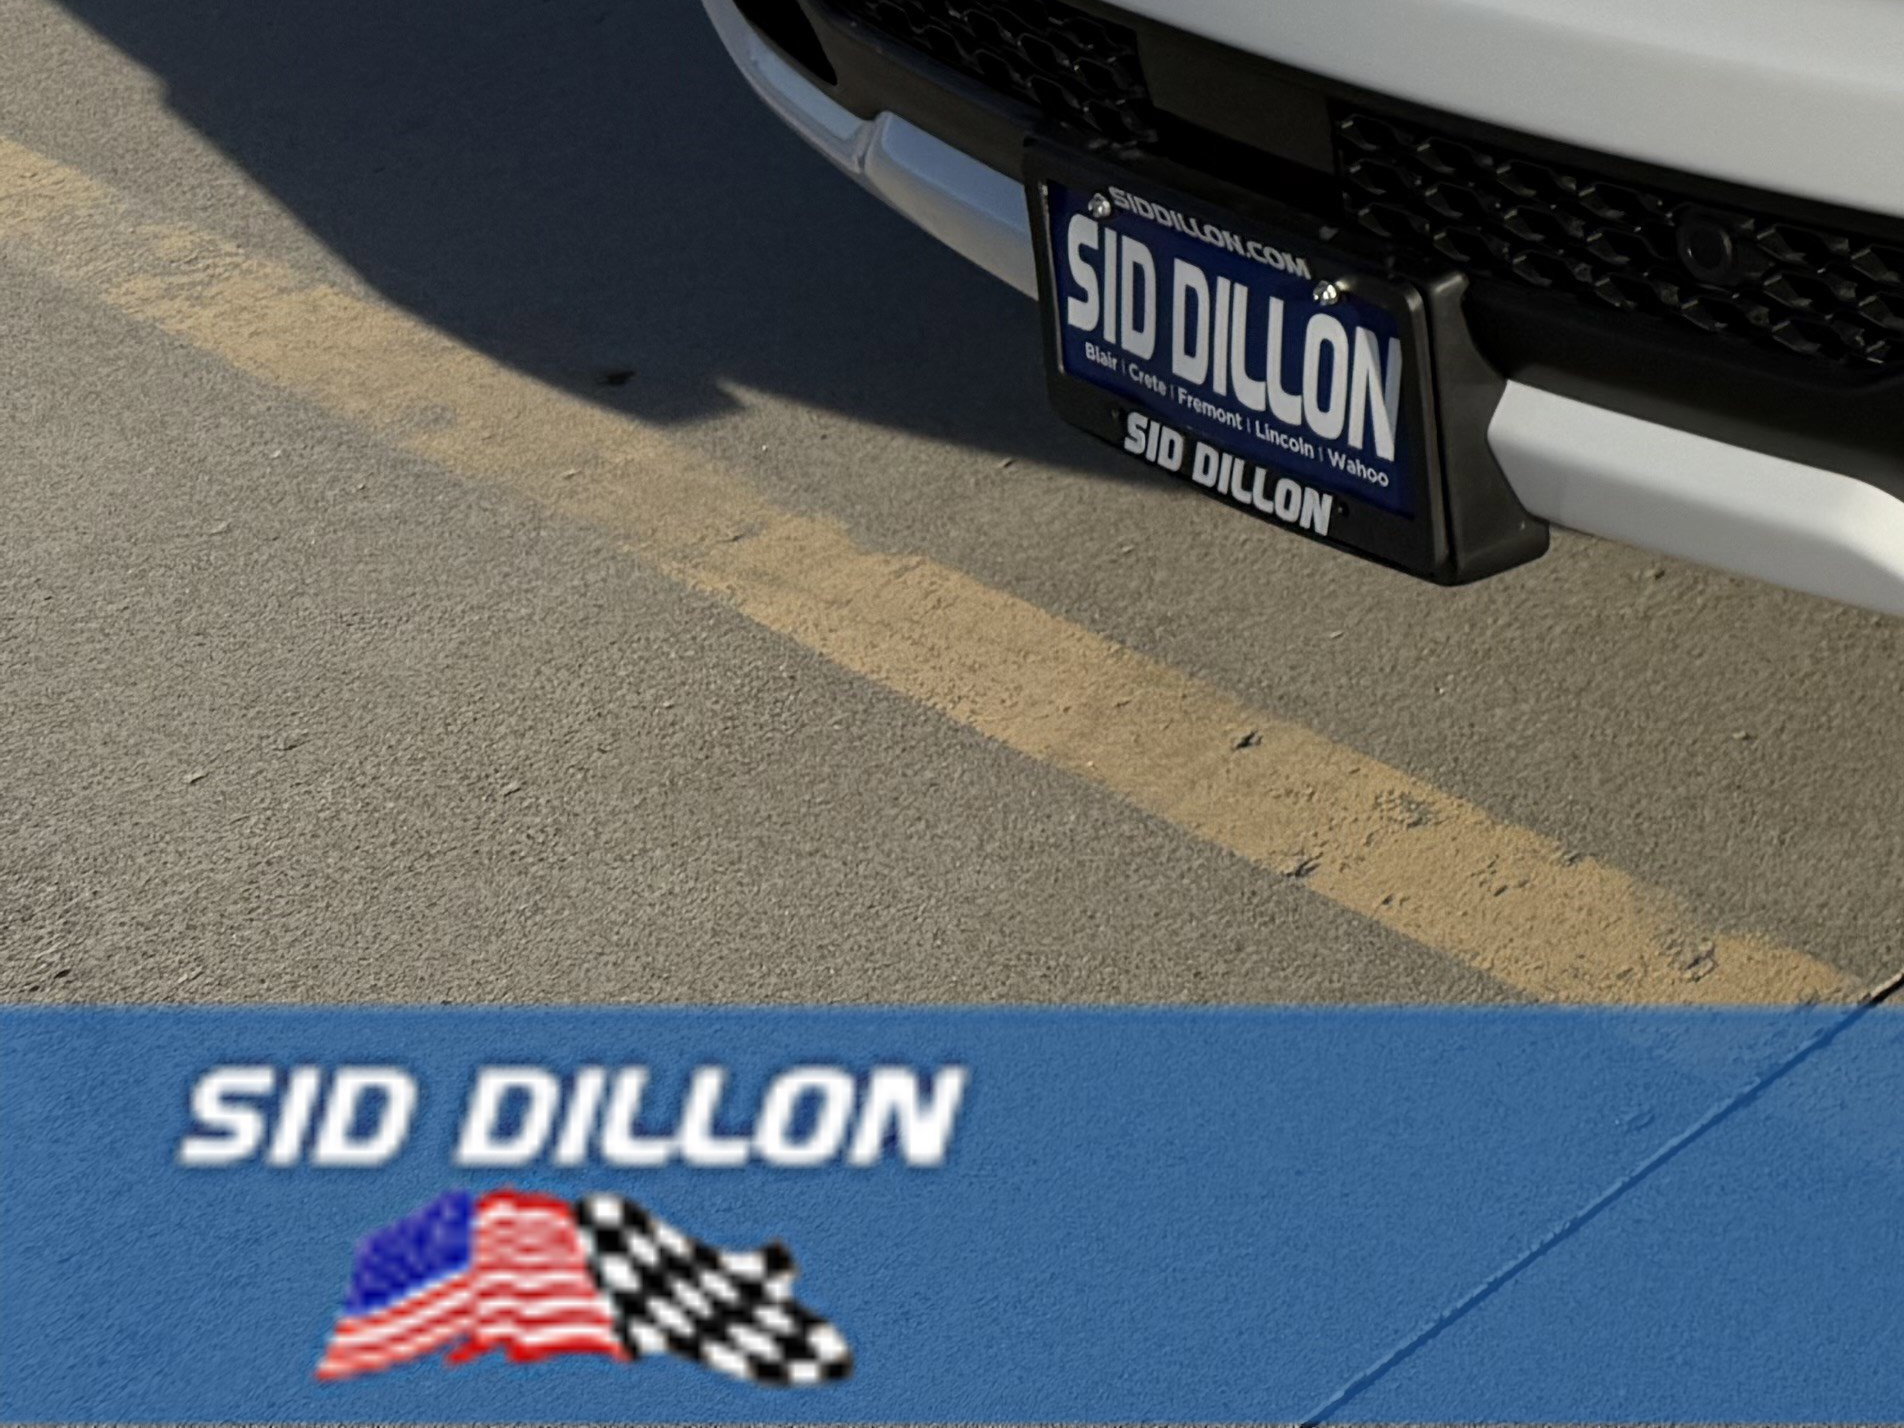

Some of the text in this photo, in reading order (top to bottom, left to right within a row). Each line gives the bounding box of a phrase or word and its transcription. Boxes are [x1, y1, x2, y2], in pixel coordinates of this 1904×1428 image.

[1108, 185, 1312, 280] SIDDILLON.COM
[1067, 213, 1402, 462] SID DILLON
[1085, 342, 1390, 488] Blair Crete Fremont Lincoln Wahoo
[1123, 411, 1334, 537] SID DILLON
